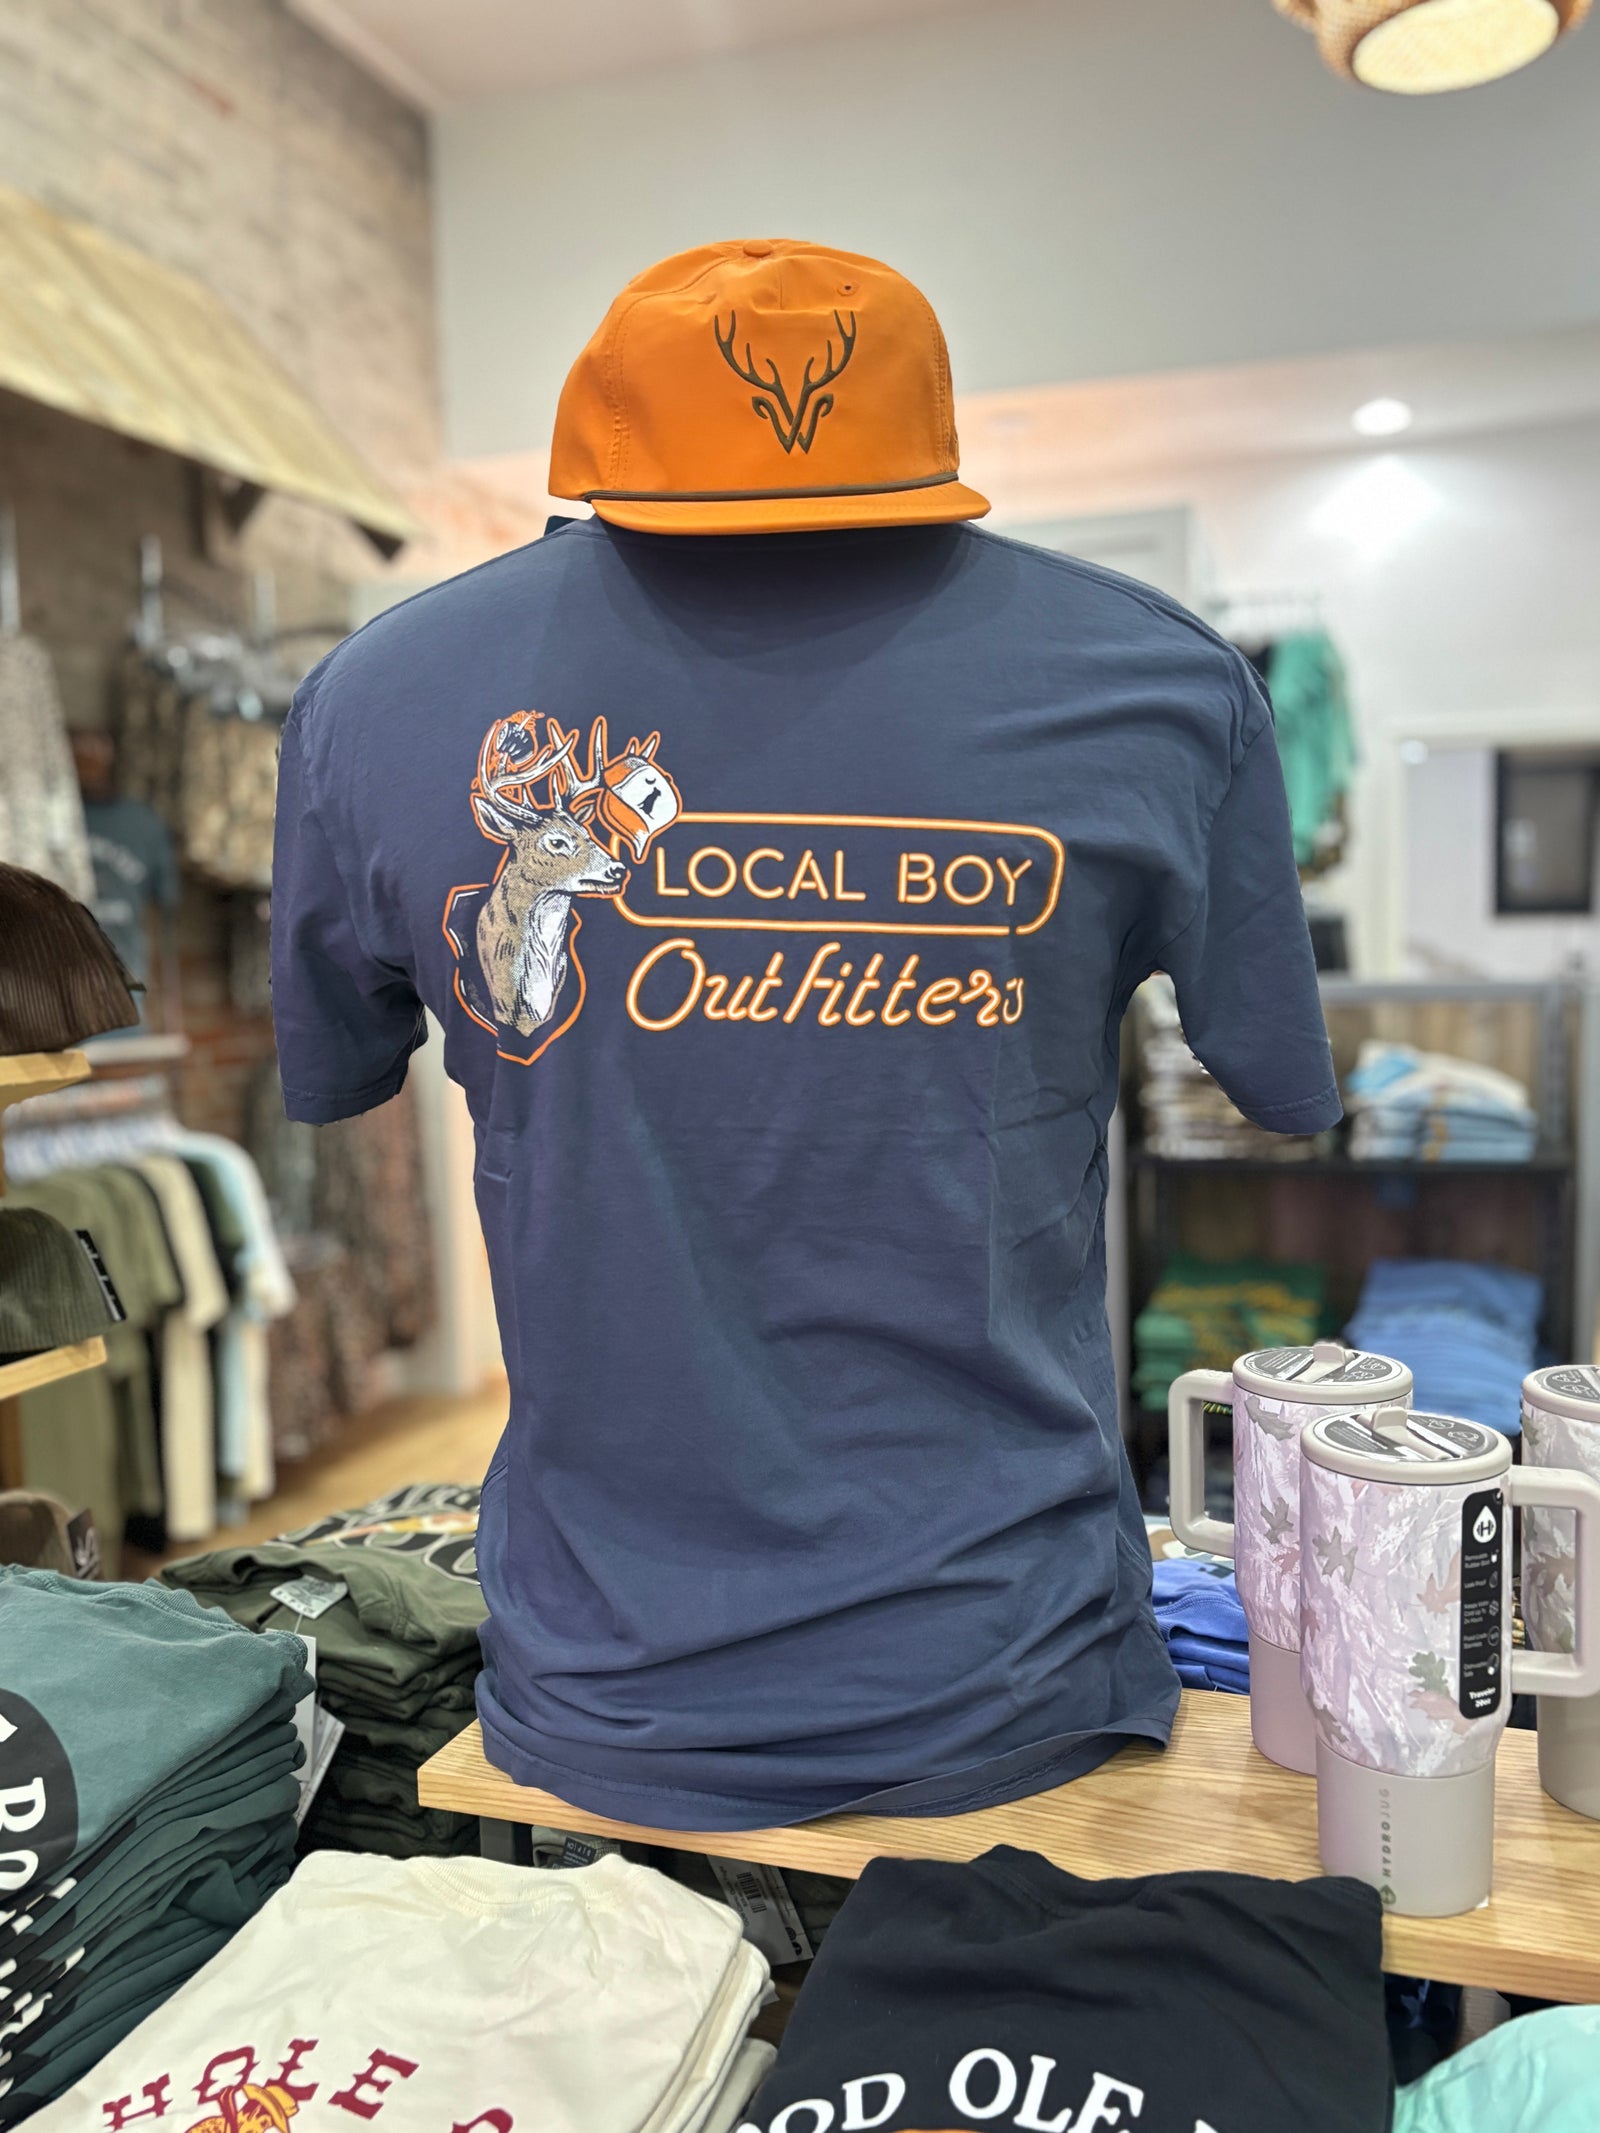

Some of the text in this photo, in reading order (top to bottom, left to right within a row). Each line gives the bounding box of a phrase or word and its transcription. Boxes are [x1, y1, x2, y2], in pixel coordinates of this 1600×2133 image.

[655, 846, 1032, 906] LOCAL BOY
[626, 937, 1025, 1031] Outfitters
